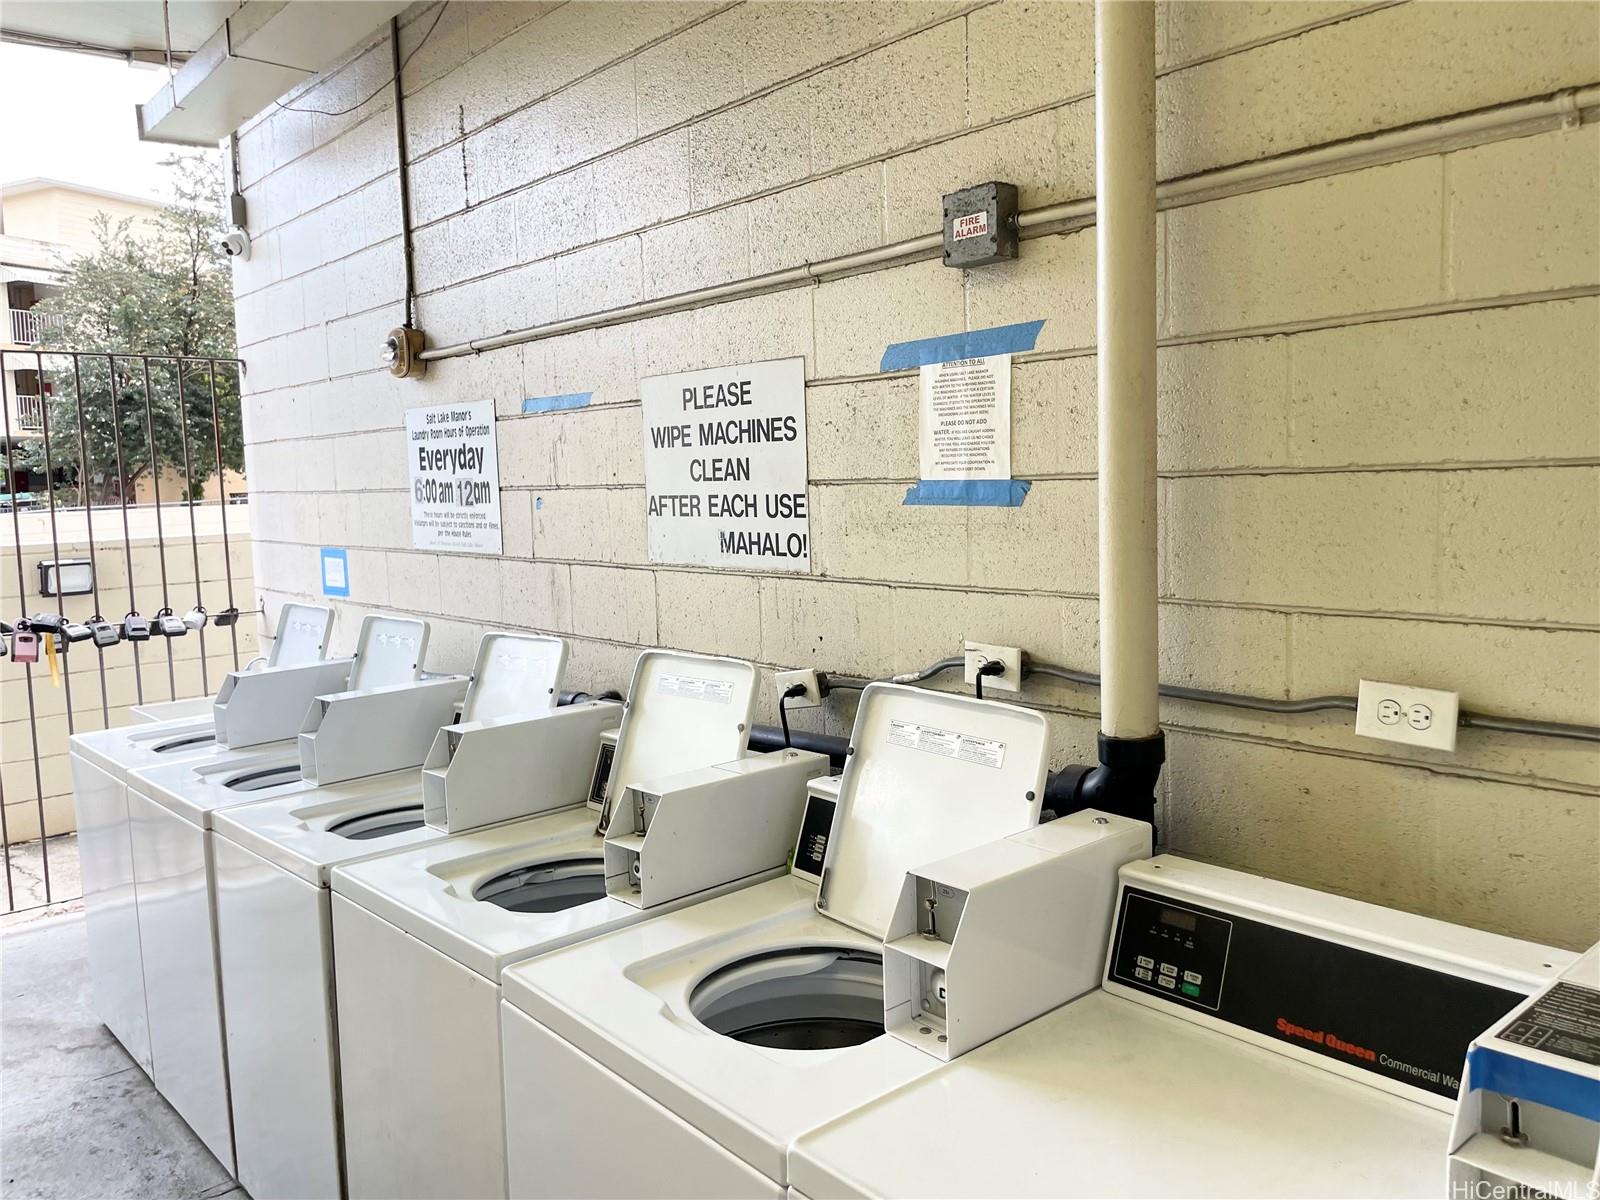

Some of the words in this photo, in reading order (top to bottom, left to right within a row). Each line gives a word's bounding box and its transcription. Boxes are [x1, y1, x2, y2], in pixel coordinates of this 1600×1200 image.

[955, 224, 986, 238] ALARM
[960, 216, 980, 227] FIRE
[682, 380, 752, 410] PLEASE
[426, 413, 436, 424] Salt
[438, 412, 449, 423] Lake
[451, 411, 472, 422] Manor's
[412, 429, 429, 441] Laundry
[430, 429, 442, 439] Room
[444, 428, 457, 438] Hours
[459, 426, 464, 437] of
[466, 424, 490, 438] Operation
[651, 425, 691, 448] WIPE
[699, 416, 797, 446] MACHINES
[419, 443, 484, 475] Everyday
[690, 458, 750, 482] CLEAN
[649, 495, 701, 516] AFTER
[709, 494, 758, 517] EACH
[766, 494, 806, 518] USE
[720, 531, 808, 558] MAHALO!
[1276, 1017, 1324, 1044] Speed
[1325, 1034, 1376, 1062] Queen
[1379, 1054, 1440, 1084] Commercial
